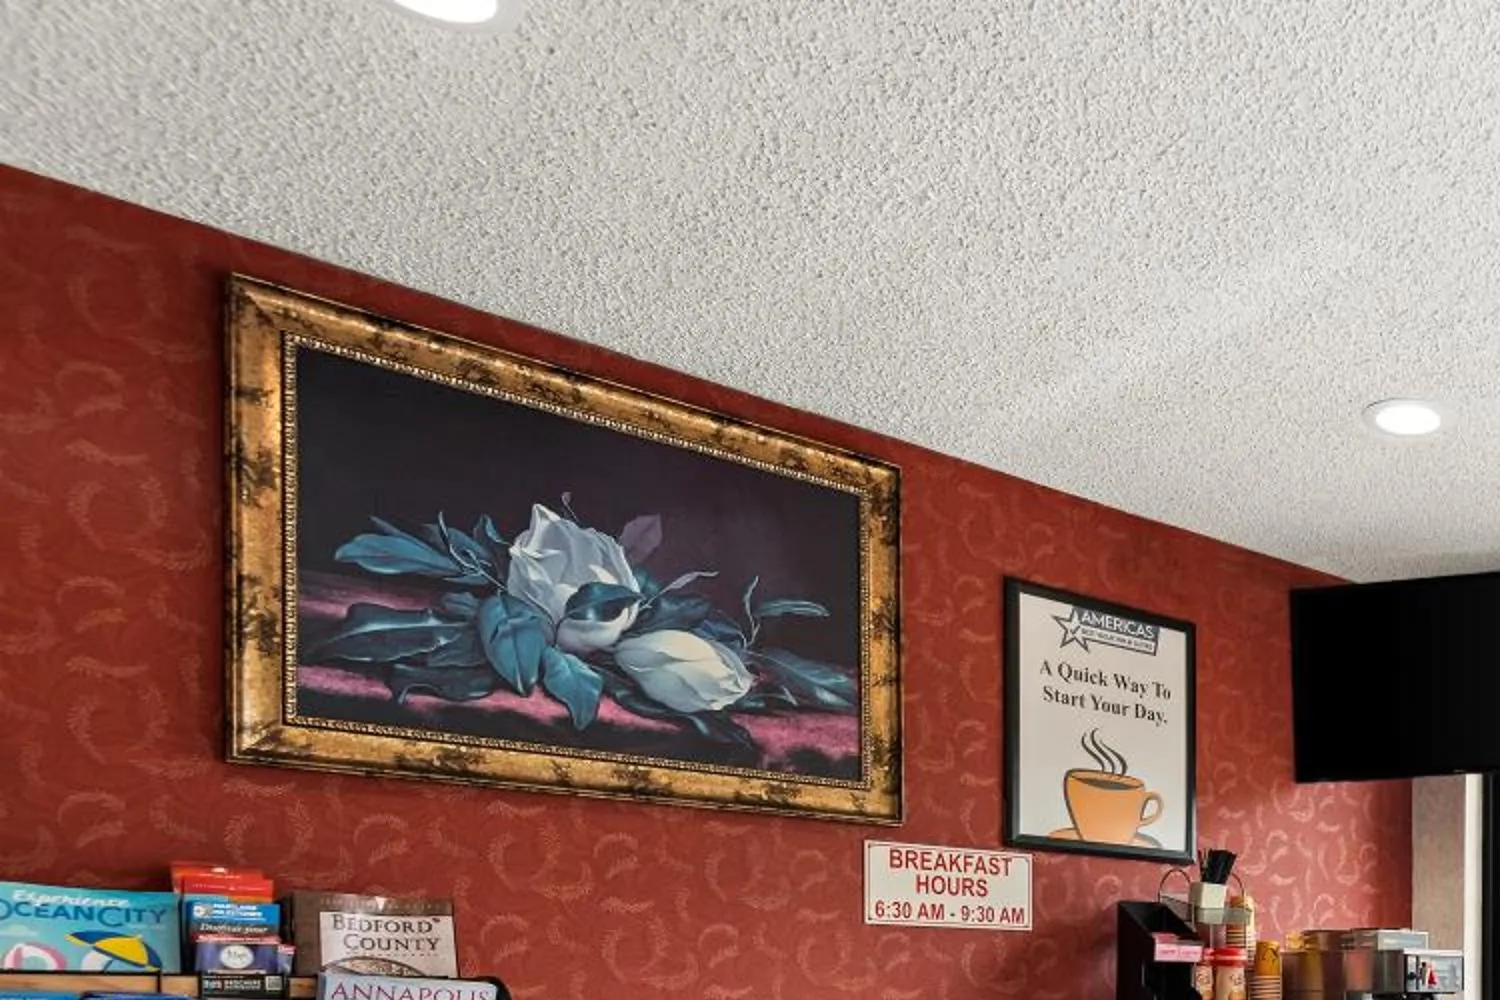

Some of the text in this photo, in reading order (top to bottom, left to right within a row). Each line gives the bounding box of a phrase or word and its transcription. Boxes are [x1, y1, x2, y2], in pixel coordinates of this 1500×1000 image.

[1081, 609, 1154, 639] AMERICAS
[1040, 660, 1171, 700] A Quick Way To
[1043, 685, 1168, 727] Start Your Day.
[889, 849, 1012, 876] BREAKFAST
[915, 875, 988, 897] HOURS
[97, 905, 167, 928] CITY
[332, 914, 433, 934] BEDFORD
[875, 900, 912, 919] 6:30
[918, 903, 945, 920] AM
[960, 905, 995, 922] 9:30
[1000, 908, 1025, 924] AM
[343, 934, 440, 951] COUNTY
